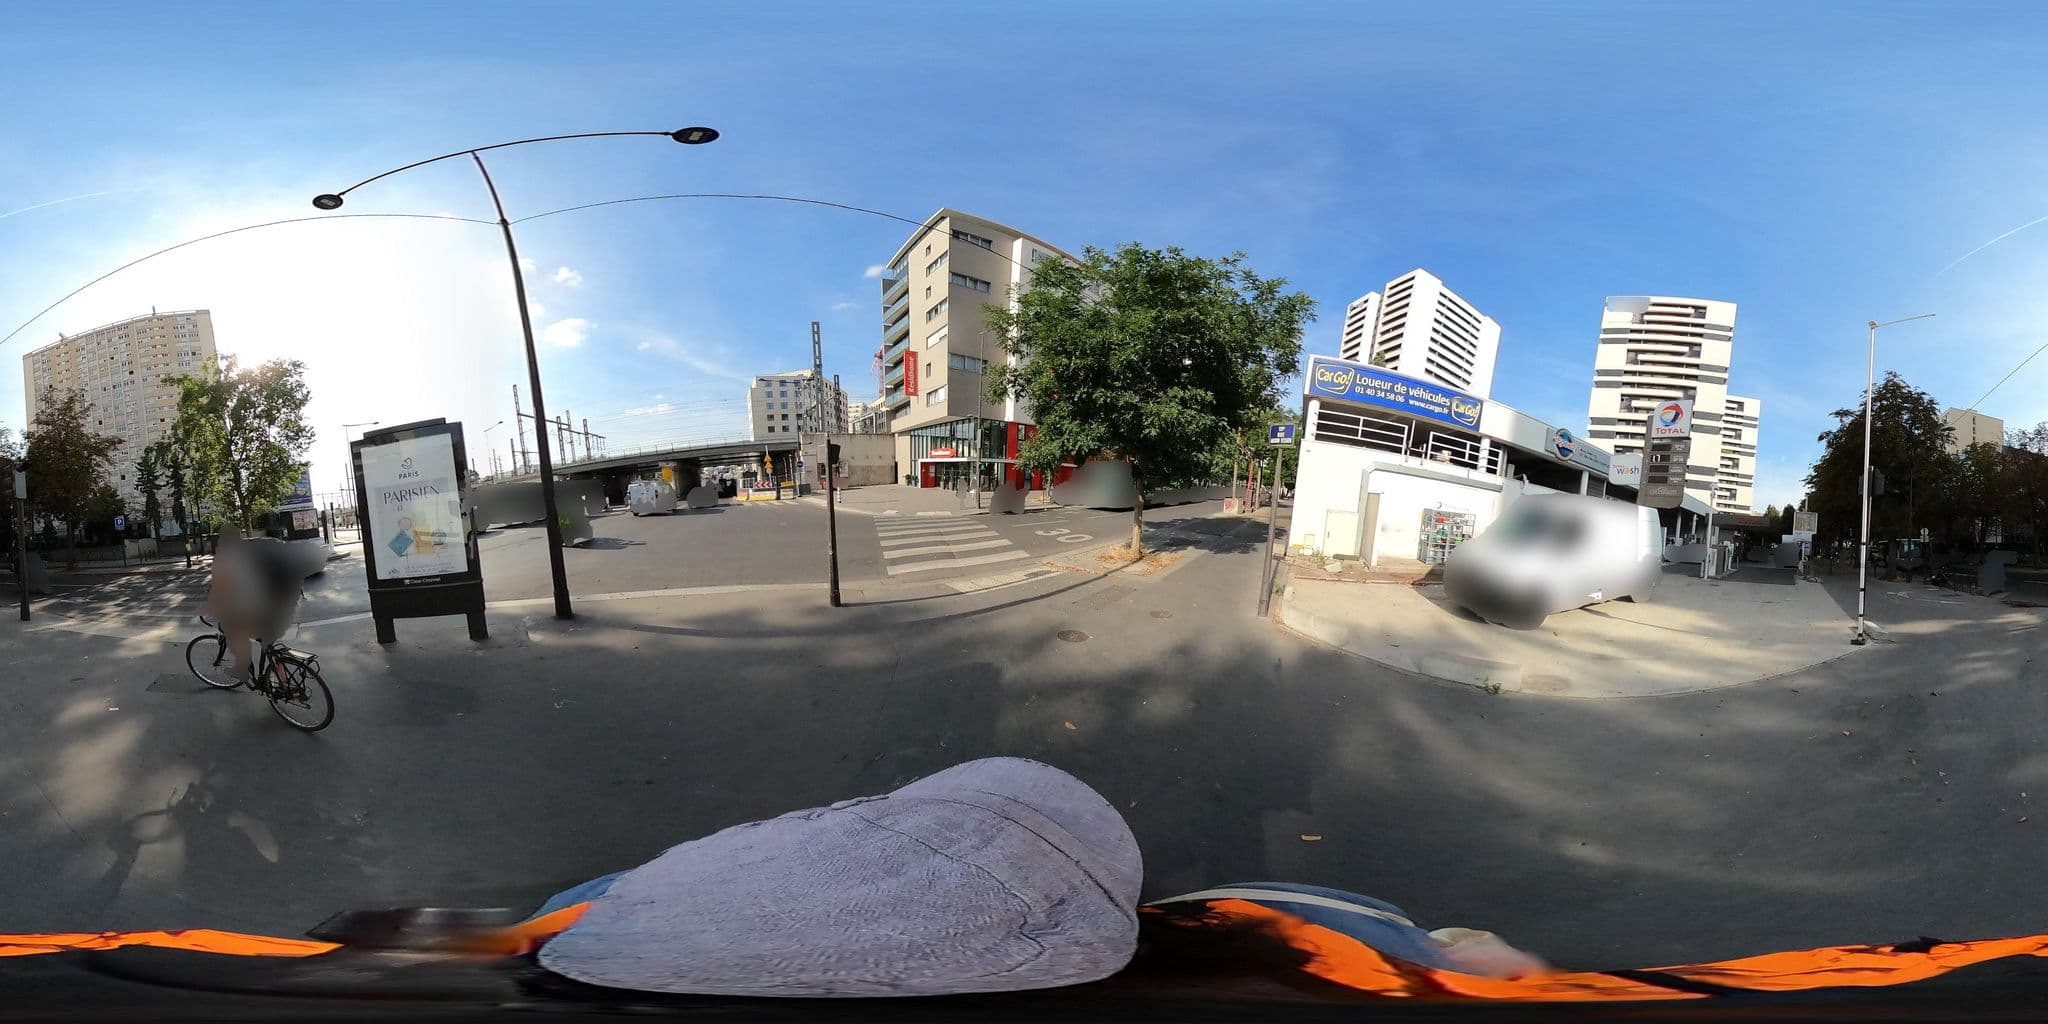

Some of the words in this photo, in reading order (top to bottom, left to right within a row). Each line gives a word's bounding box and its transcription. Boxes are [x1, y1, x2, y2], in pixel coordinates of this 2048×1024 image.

[1356, 374, 1393, 390] Loueur
[1394, 382, 1407, 393] de
[1408, 387, 1450, 406] véhicules
[1355, 386, 1364, 394] 01
[1365, 388, 1375, 396] 40
[1376, 390, 1385, 398] 34
[1386, 392, 1395, 401] 58
[1395, 394, 1405, 403] 06
[1408, 398, 1449, 414] www.cargo.fr
[398, 471, 419, 479] PARIS
[1616, 466, 1639, 475] wash
[1034, 528, 1094, 543] 30
